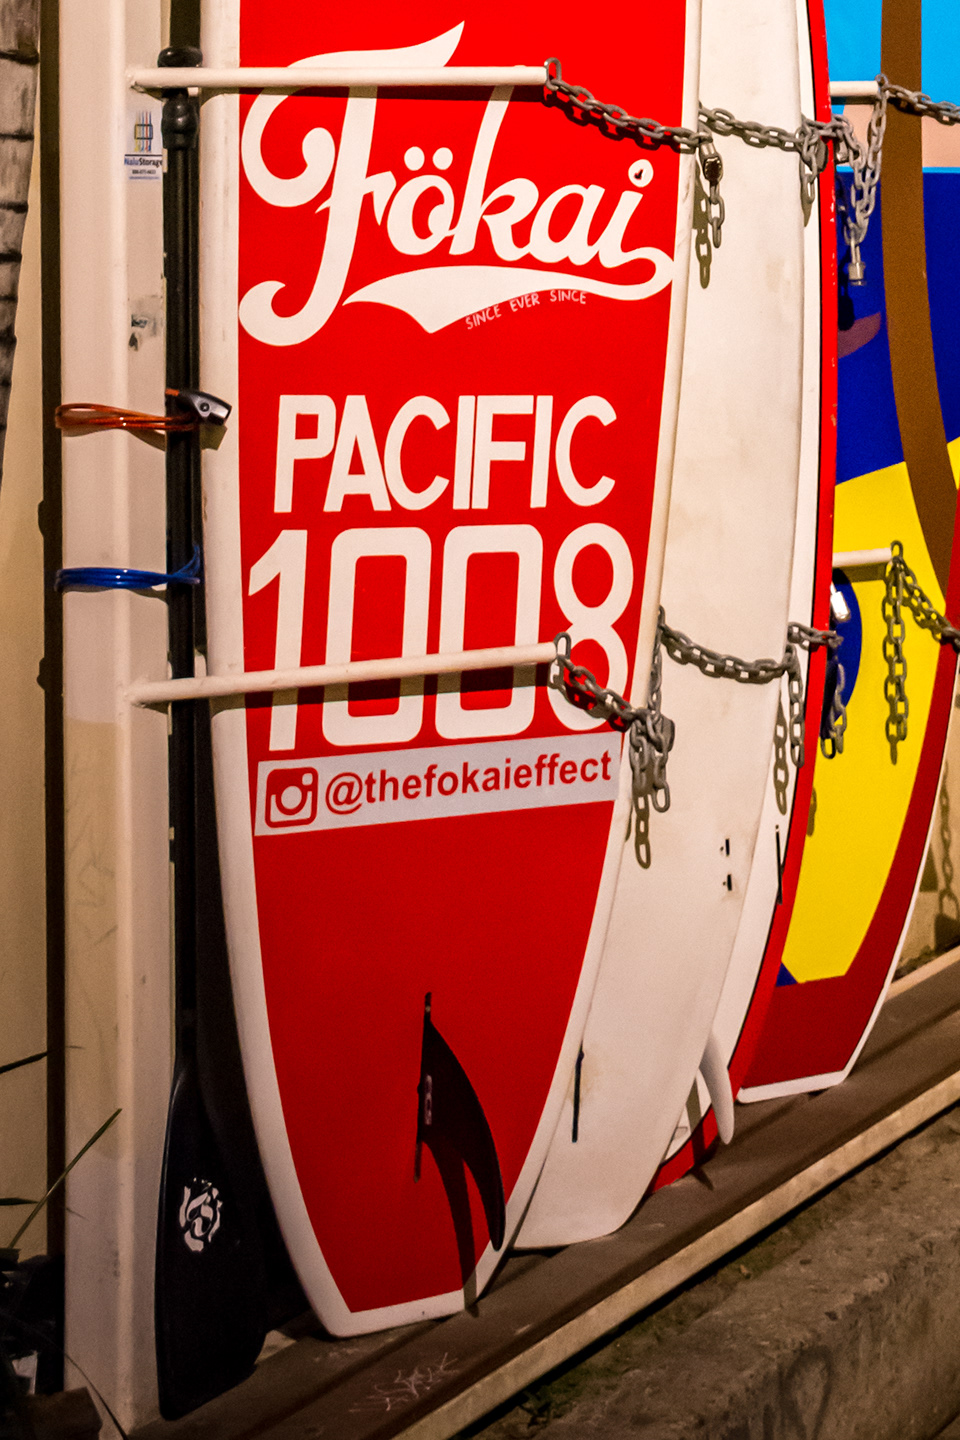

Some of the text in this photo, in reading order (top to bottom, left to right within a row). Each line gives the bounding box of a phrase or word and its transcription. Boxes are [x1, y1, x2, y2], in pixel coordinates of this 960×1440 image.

[238, 21, 675, 346] Fökai
[465, 289, 587, 330] SINCE EVER SINCE
[274, 394, 617, 513] PACIFIC
[248, 522, 634, 752] 1008
[325, 750, 613, 815] @thefokaieffect
